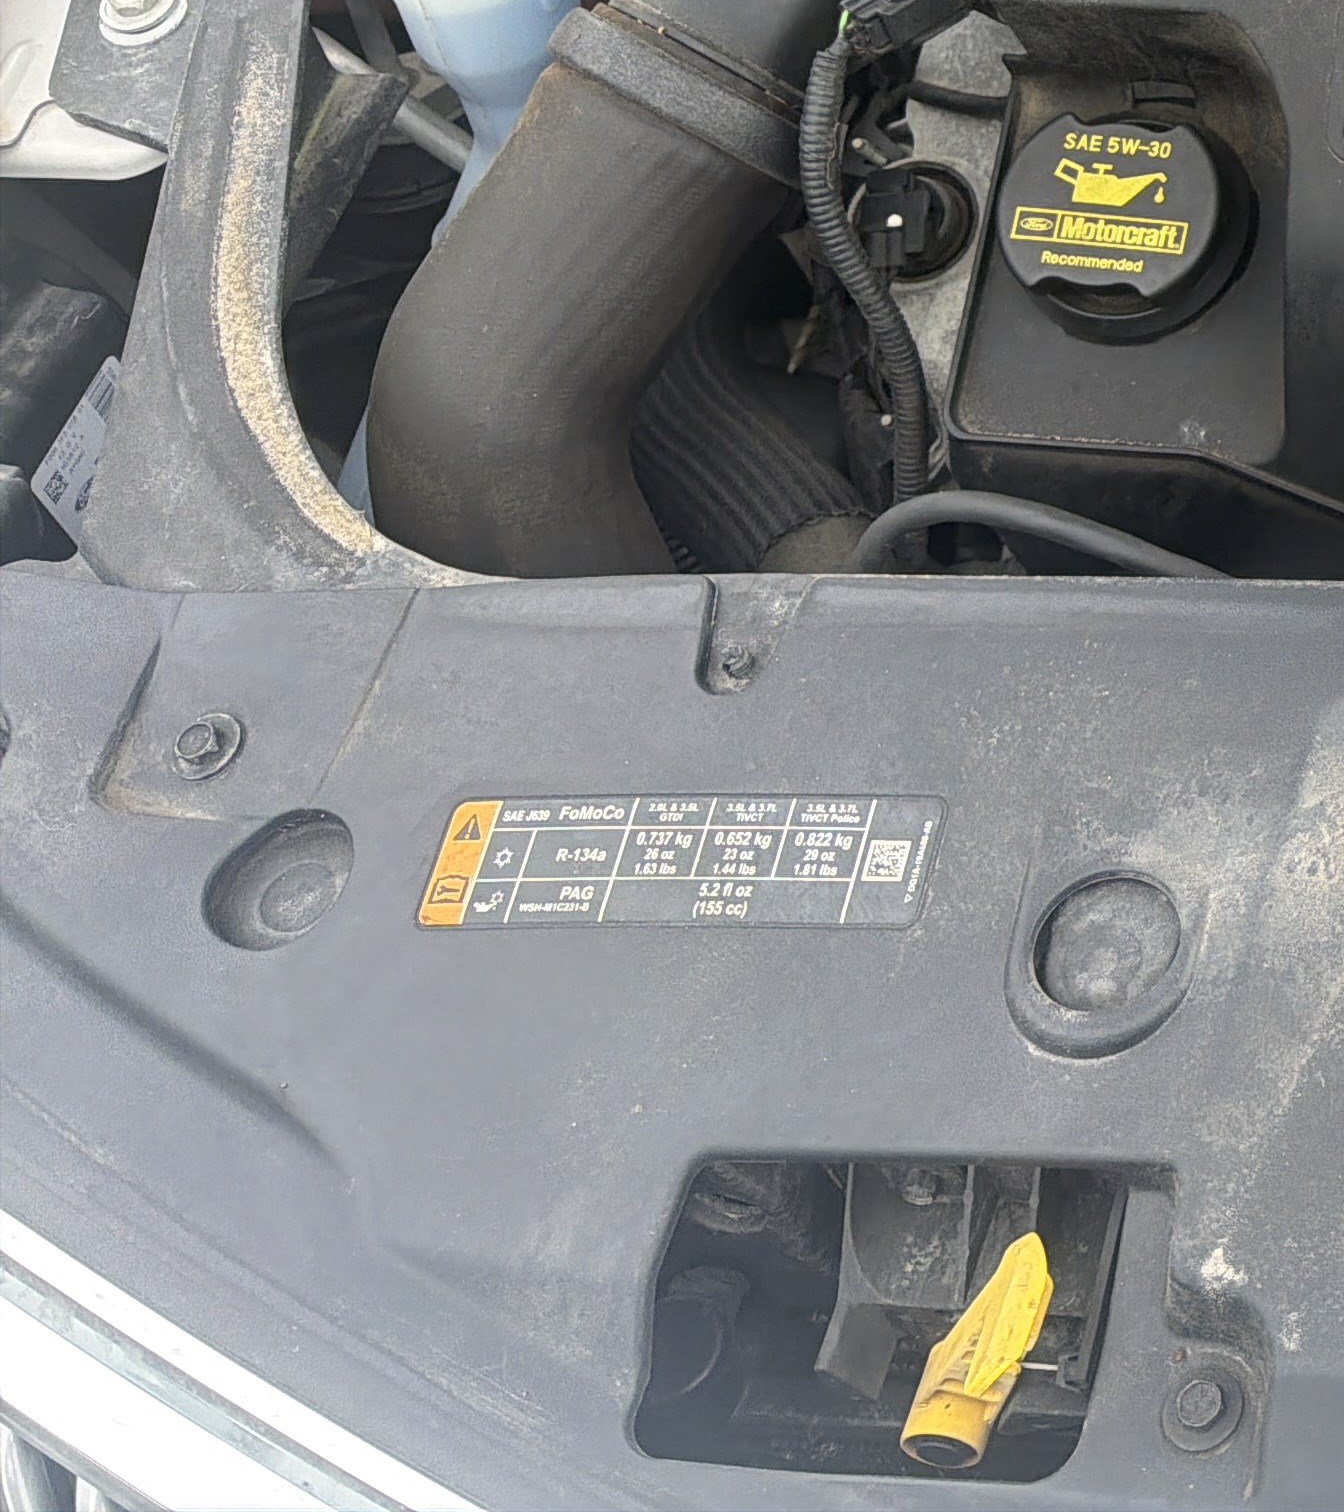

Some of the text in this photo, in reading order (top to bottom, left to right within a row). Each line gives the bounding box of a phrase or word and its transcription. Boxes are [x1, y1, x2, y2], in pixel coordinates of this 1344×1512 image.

[1063, 132, 1172, 159] SAE 5W-30
[1040, 250, 1144, 273] Recommended
[502, 810, 525, 822] SAE
[559, 806, 625, 820] FoMoCo
[830, 813, 860, 824] Police
[636, 831, 693, 848] 0.737 kg
[714, 832, 772, 849] 0.652 kg
[794, 832, 853, 850] 0.822 kg
[556, 848, 607, 862] R-134a
[643, 848, 675, 860] 26 oz
[722, 849, 754, 860] 23 oz
[803, 849, 835, 861] 29 oz
[634, 863, 677, 875] 1.63 lbs
[713, 863, 756, 875] 1.44 lbs
[793, 864, 837, 876] 1.81 lbs
[560, 886, 595, 900] PAG
[699, 883, 753, 897] 5.2 fl oz
[693, 900, 748, 919] (155 cc)
